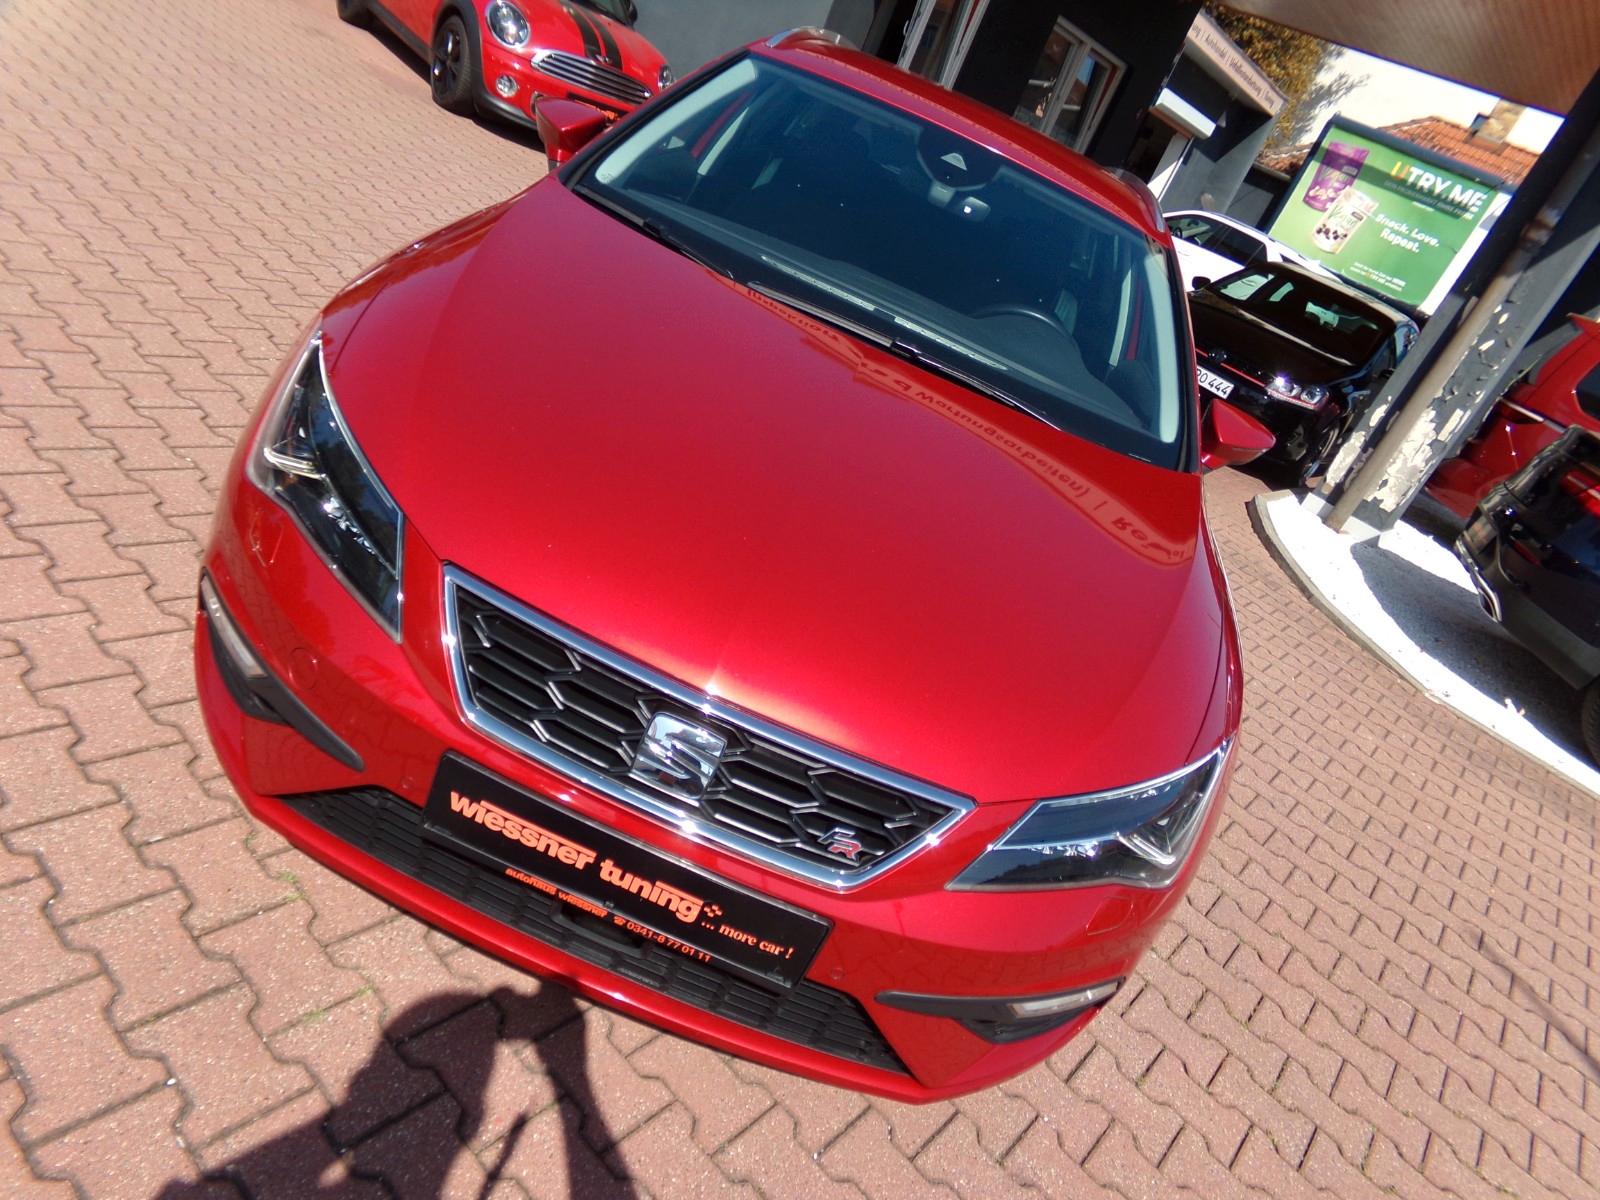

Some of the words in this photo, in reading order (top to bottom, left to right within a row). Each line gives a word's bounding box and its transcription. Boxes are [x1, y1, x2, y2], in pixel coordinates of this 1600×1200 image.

[1380, 227, 1420, 253] Repeat.
[1411, 227, 1439, 248] Love.
[1208, 377, 1231, 396] 444
[450, 791, 597, 870] wiessner
[599, 858, 705, 923] tuning
[505, 868, 557, 895] autohaus
[719, 923, 757, 947] more
[759, 940, 785, 956] car
